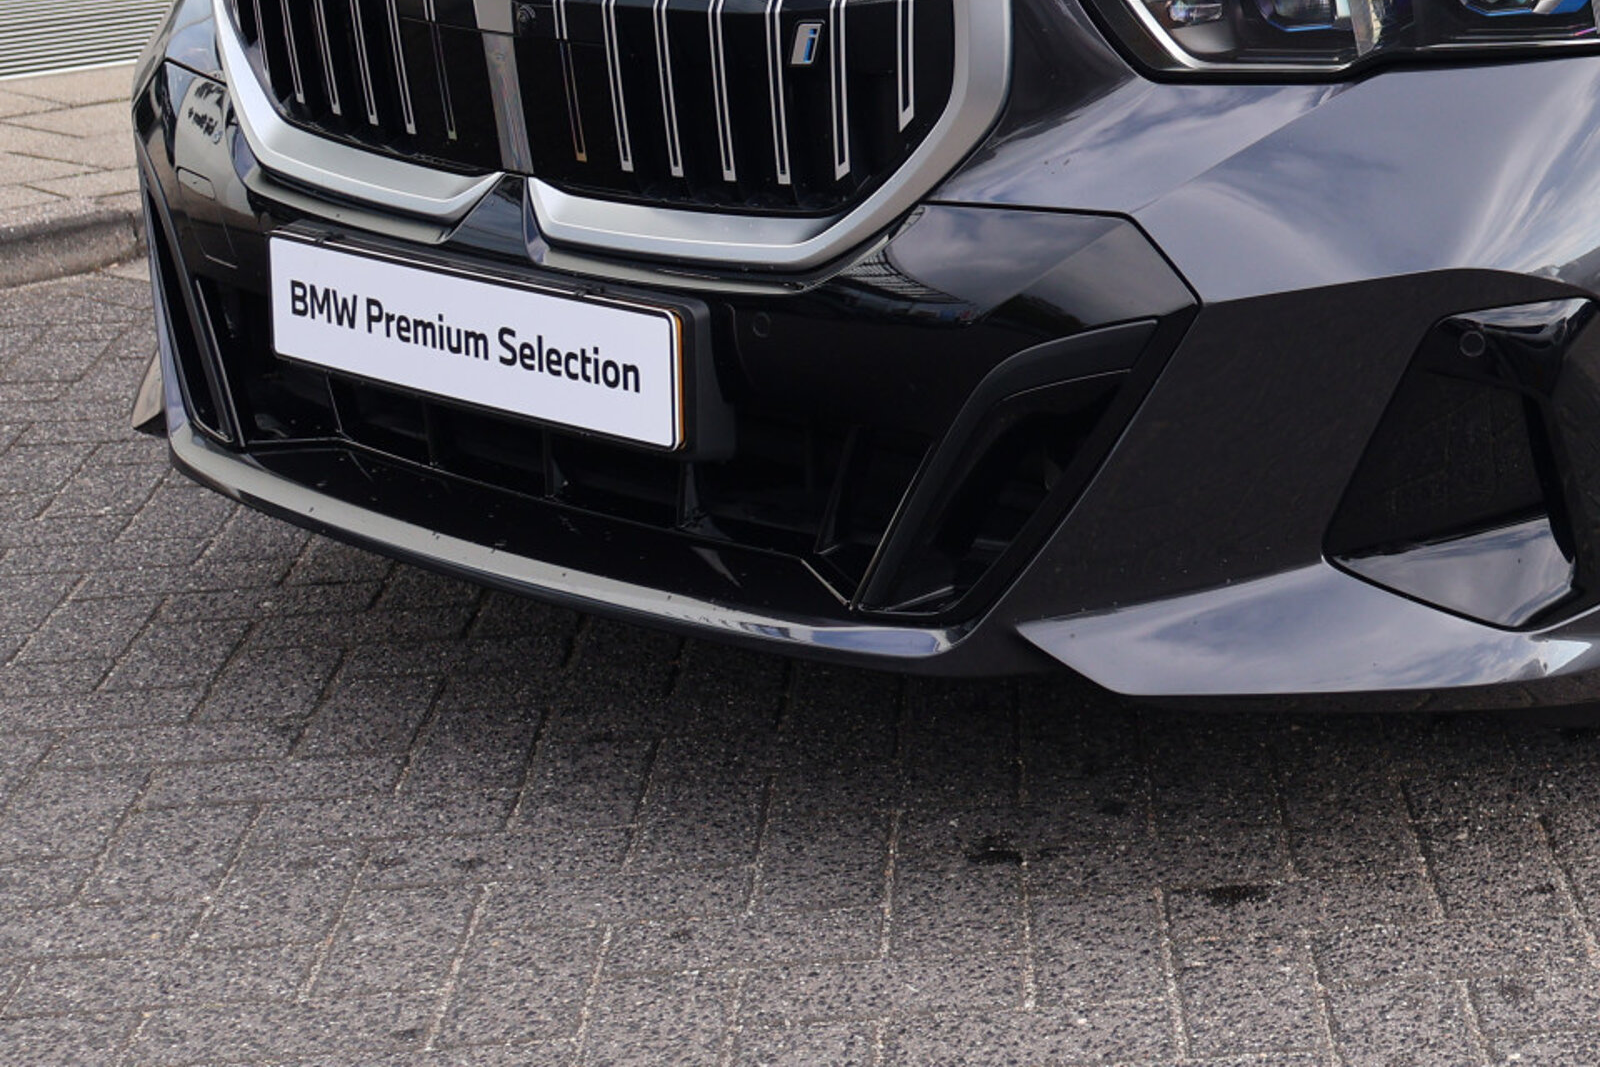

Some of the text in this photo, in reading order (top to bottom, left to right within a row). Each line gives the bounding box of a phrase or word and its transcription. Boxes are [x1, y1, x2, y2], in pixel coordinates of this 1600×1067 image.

[290, 279, 641, 393] BMW Premium Selection
